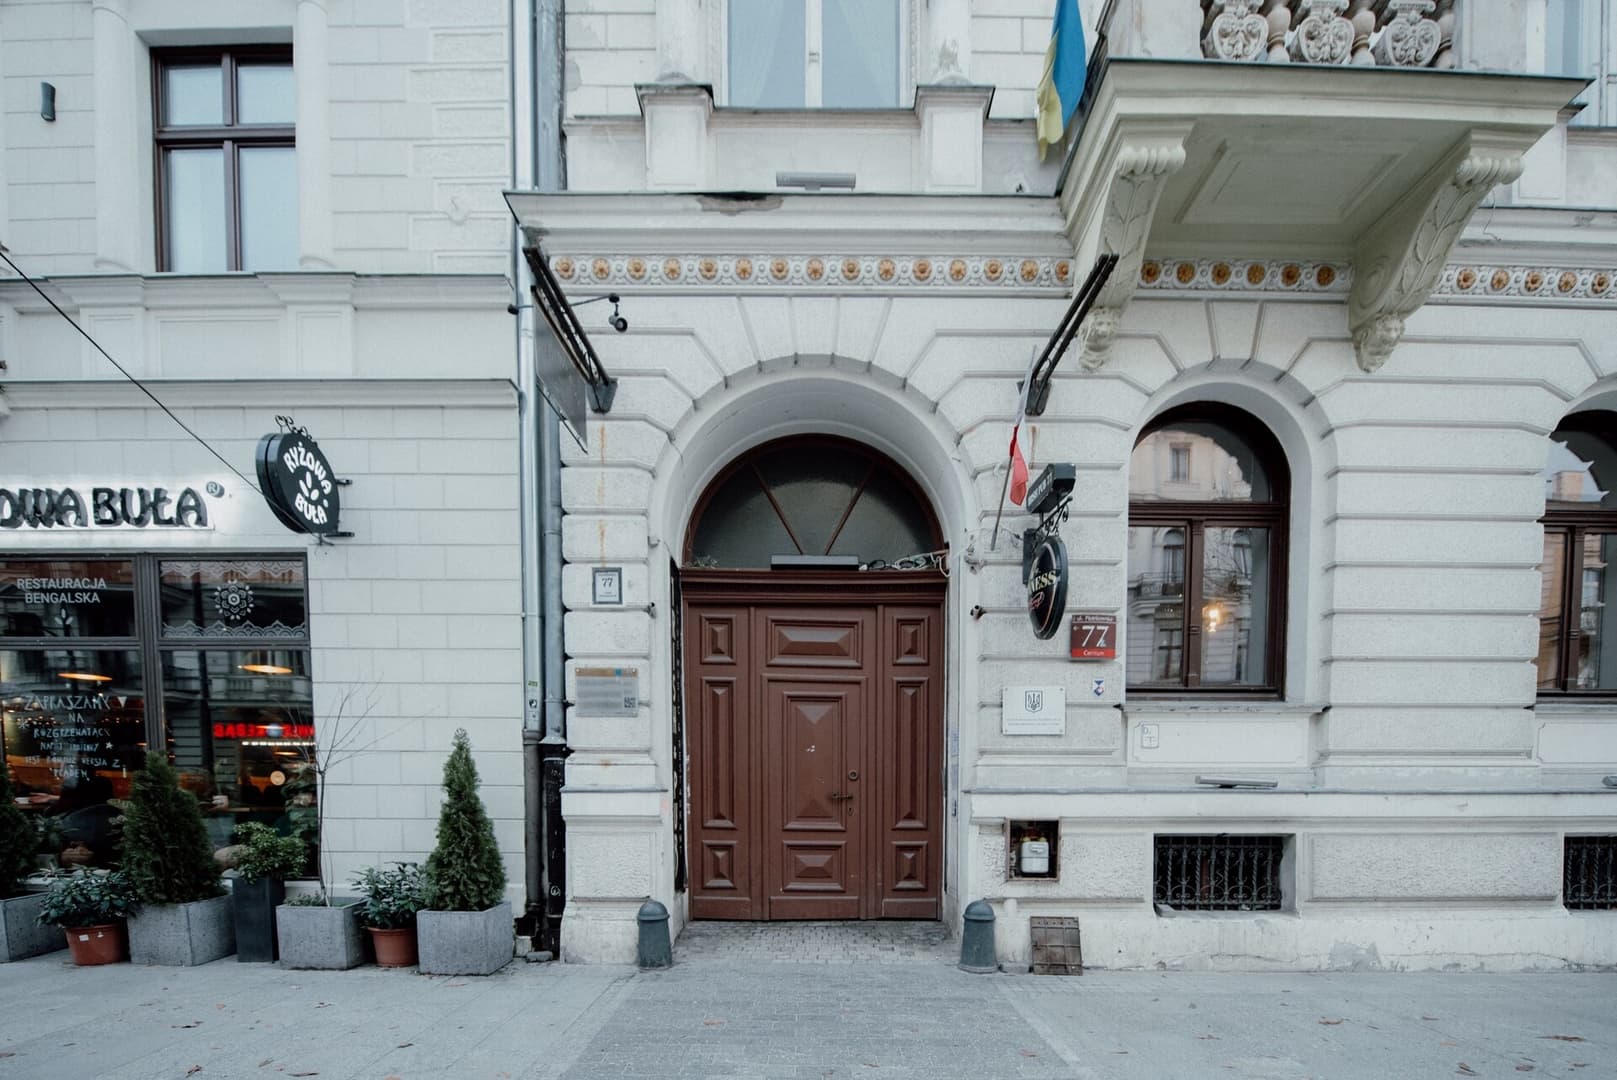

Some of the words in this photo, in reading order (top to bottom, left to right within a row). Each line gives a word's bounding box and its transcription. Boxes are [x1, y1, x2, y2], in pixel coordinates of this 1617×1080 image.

[283, 441, 332, 494] RYŻOWA
[92, 487, 208, 527] BUŁA
[295, 493, 328, 524] BUŁA
[16, 577, 107, 590] RESTAURACJA
[602, 577, 613, 588] 77
[25, 592, 101, 604] BENGALSKA
[1082, 625, 1109, 647] 77
[24, 696, 110, 710] ZAPRASZAMY
[69, 713, 84, 723] NA
